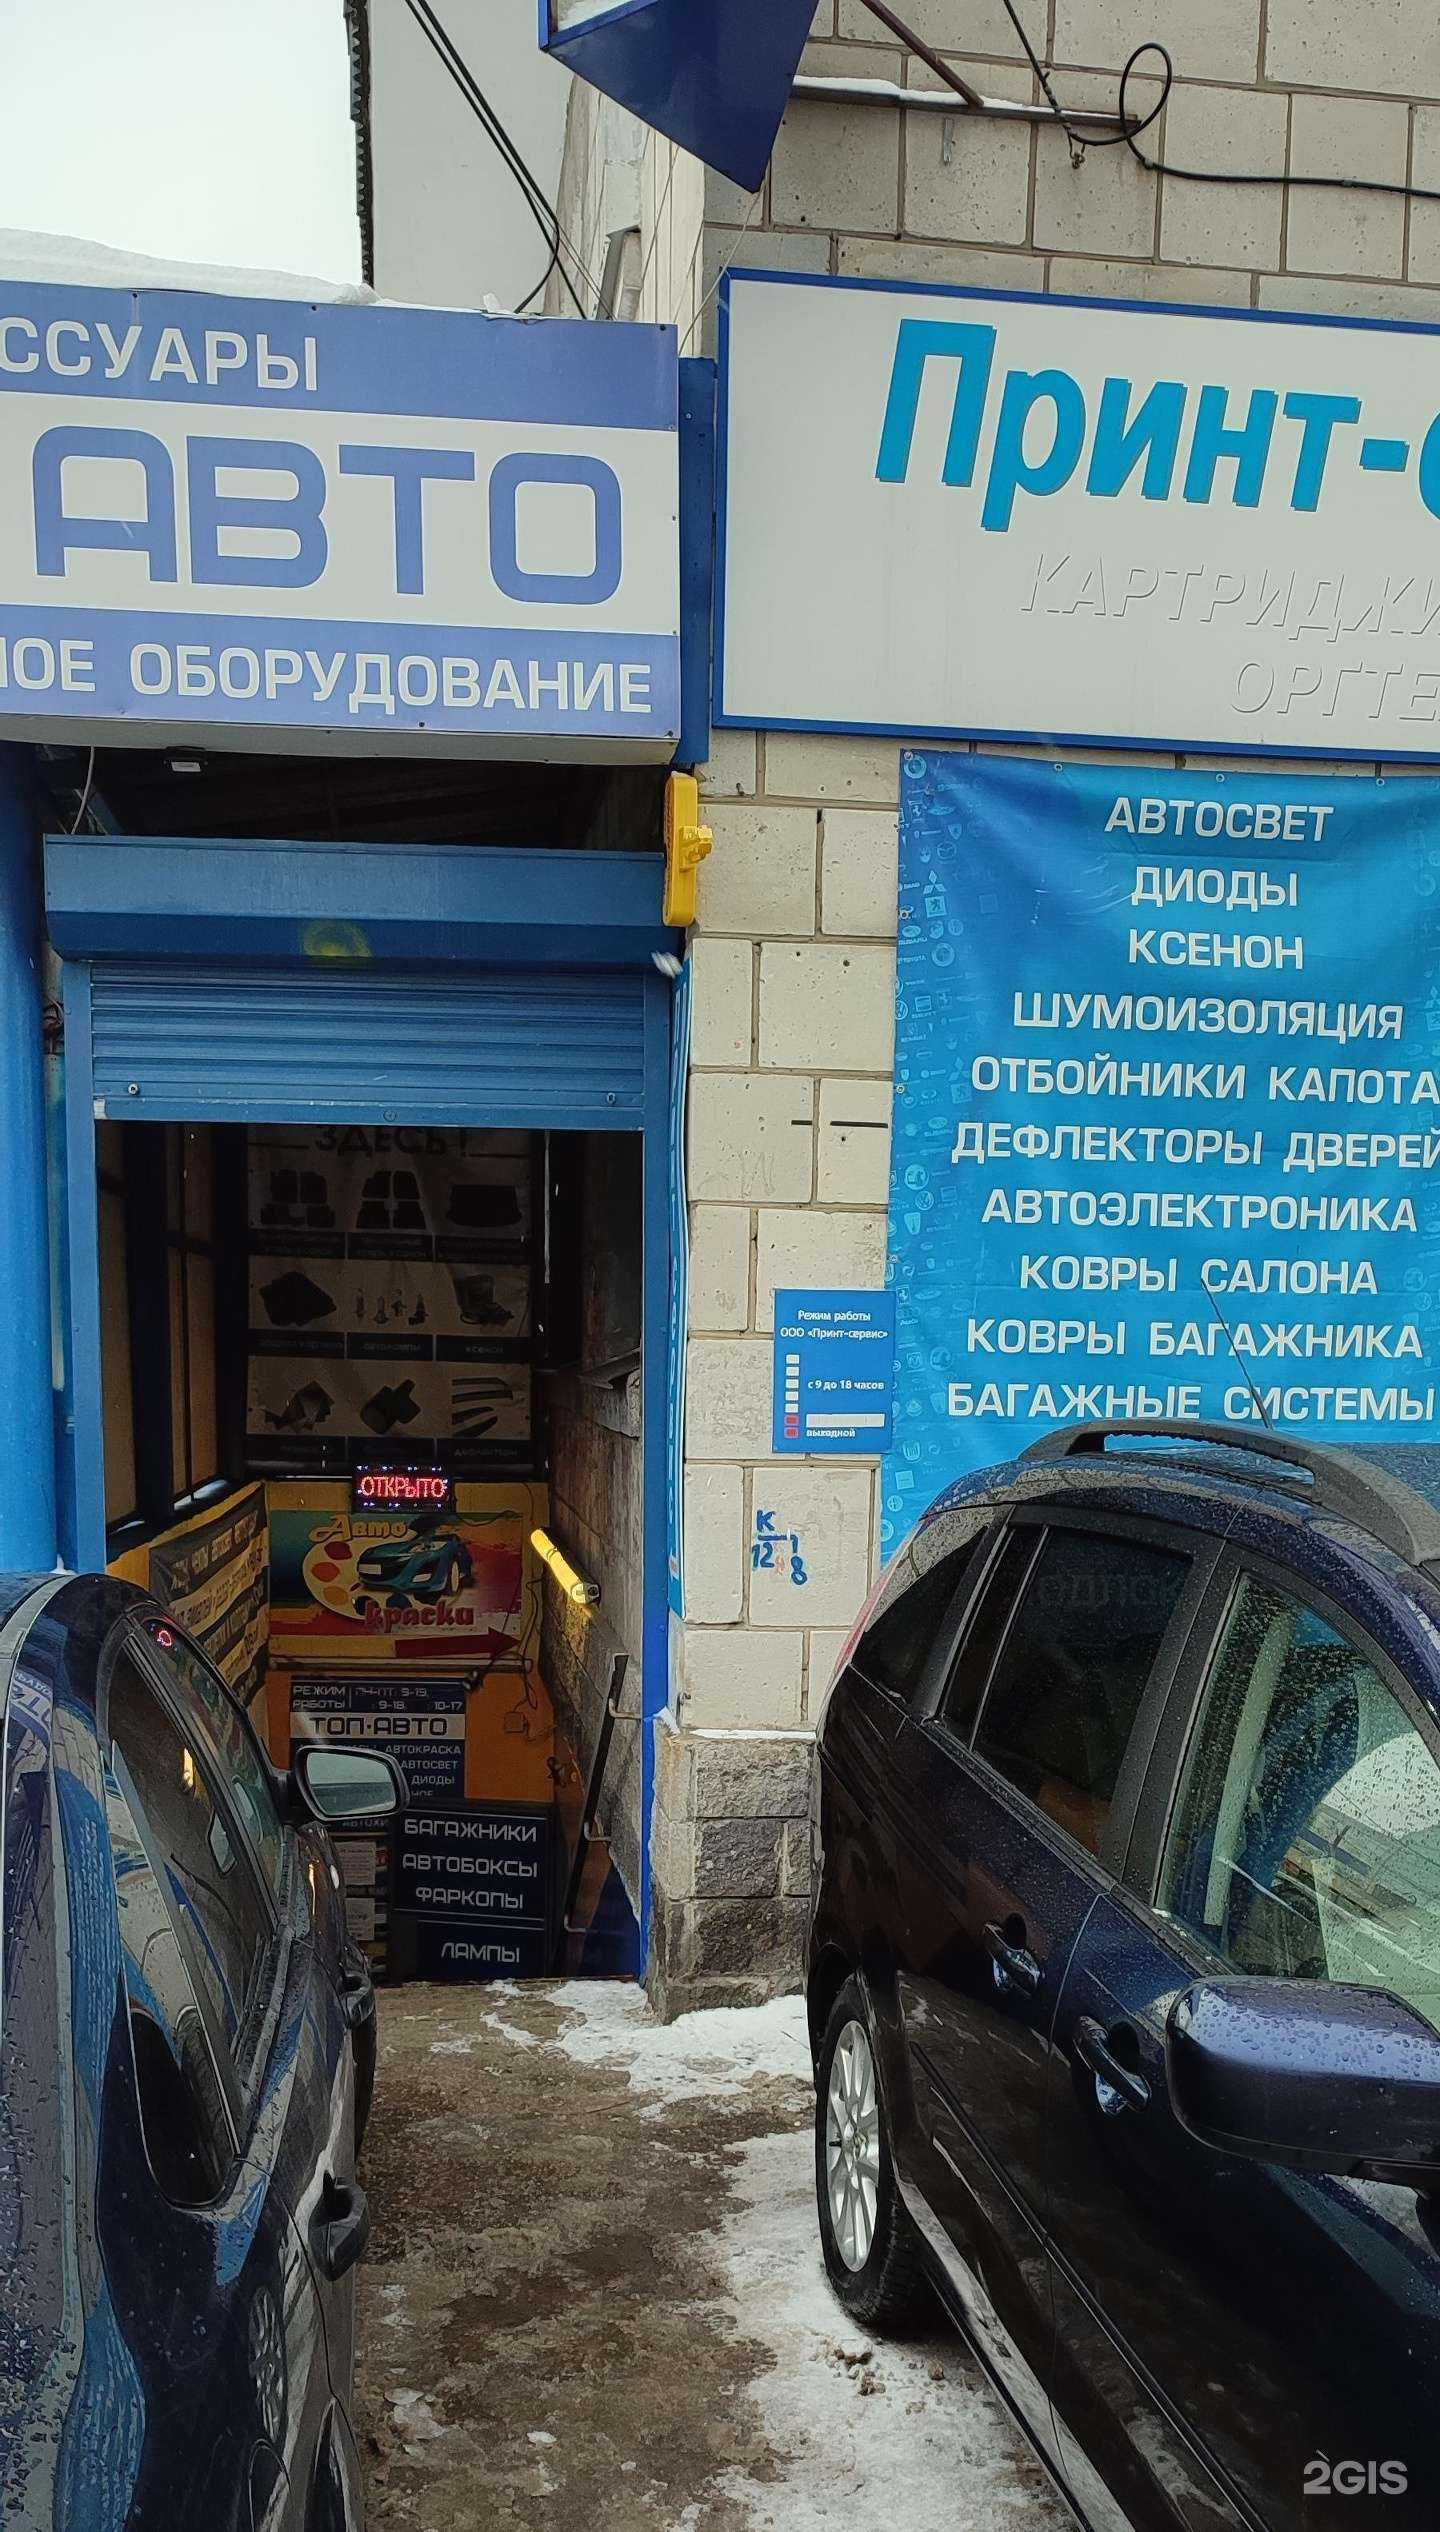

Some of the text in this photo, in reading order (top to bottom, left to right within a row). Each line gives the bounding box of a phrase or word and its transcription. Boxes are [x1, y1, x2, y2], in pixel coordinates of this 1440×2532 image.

[0, 316, 319, 391] ССУАРЫ
[32, 425, 622, 606] АВТО
[0, 636, 652, 715] ОЕ ОБОРУДОВАНИЕ
[1105, 797, 1334, 842] АВТОСВЕТ
[1131, 867, 1298, 911] ДИОДЫ
[1129, 928, 1304, 969] КСЕНОН
[1013, 992, 1403, 1044] ШУМОИЗОЛЯЦИЯ
[972, 1052, 1440, 1105] ОТБОЙНИКИ КАПОТА
[952, 1121, 1440, 1171] ДЕФЛЕКТОРЫ ДВЕРЕЙ
[982, 1188, 1418, 1233] АВТОЭЛЕКТРОНИКА
[1020, 1255, 1378, 1295] КОВРЫ САЛОНА
[797, 1309, 871, 1323] Режим работы
[780, 1327, 805, 1338] ООО
[967, 1318, 1423, 1360] КОВРЫ БАГАЖНИКА
[823, 1381, 838, 1392] до
[840, 1380, 852, 1390] 18
[854, 1381, 885, 1390] часов
[947, 1382, 1434, 1422] БАГАЖНЫЕ СИСТЕМЫ
[806, 1428, 857, 1439] выходной
[360, 1475, 445, 1498] ОТКРЫТО
[293, 1685, 346, 1696] РЕЖИМ
[293, 1699, 345, 1709] РАБОТЫ
[384, 1744, 462, 1755] АВТОКРАСКА
[400, 1759, 459, 1770] АВТОСВЕТ
[410, 1774, 456, 1786] ДИОДЫ
[404, 1818, 537, 1842] БАГАЖНИКИ
[402, 1853, 538, 1878] АВТОБОКСЫ
[415, 1886, 523, 1910] ФАРКОПЫ
[440, 1942, 520, 1964] ЛАМПЫ
